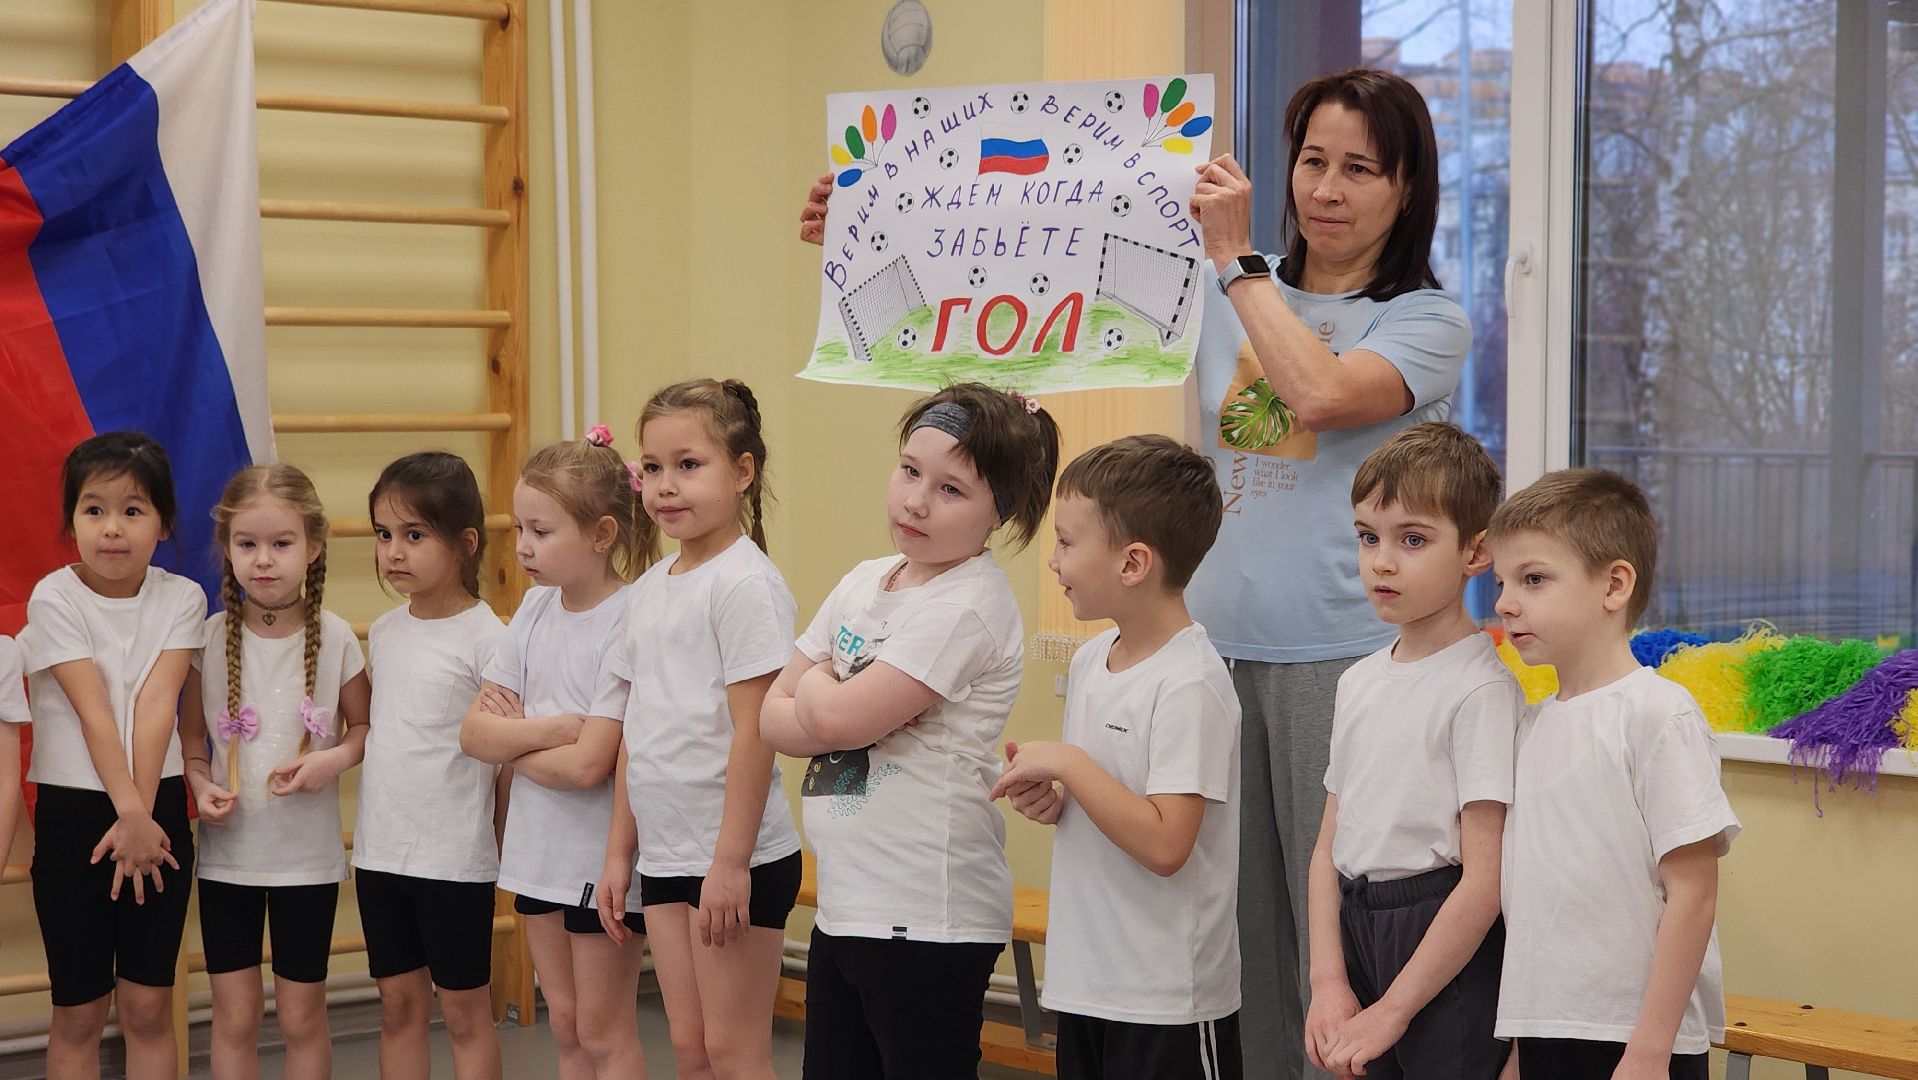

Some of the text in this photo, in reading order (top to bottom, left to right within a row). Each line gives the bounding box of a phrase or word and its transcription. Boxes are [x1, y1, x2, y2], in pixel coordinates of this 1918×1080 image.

[884, 162, 898, 180] В
[904, 92, 994, 164] НАШИХ
[1040, 95, 1201, 249] ВЕРИМ В СПОРТ
[921, 179, 1105, 211] ЖДЕМ КОГДА
[927, 221, 1085, 258] ЗАБЬЁТЕ
[931, 292, 1084, 355] ГОЛ
[1254, 468, 1273, 478] what
[1281, 470, 1298, 482] look
[1262, 459, 1291, 470] wonder
[1222, 451, 1248, 517] New
[1250, 489, 1267, 499] eyes
[1252, 476, 1296, 492] like in your
